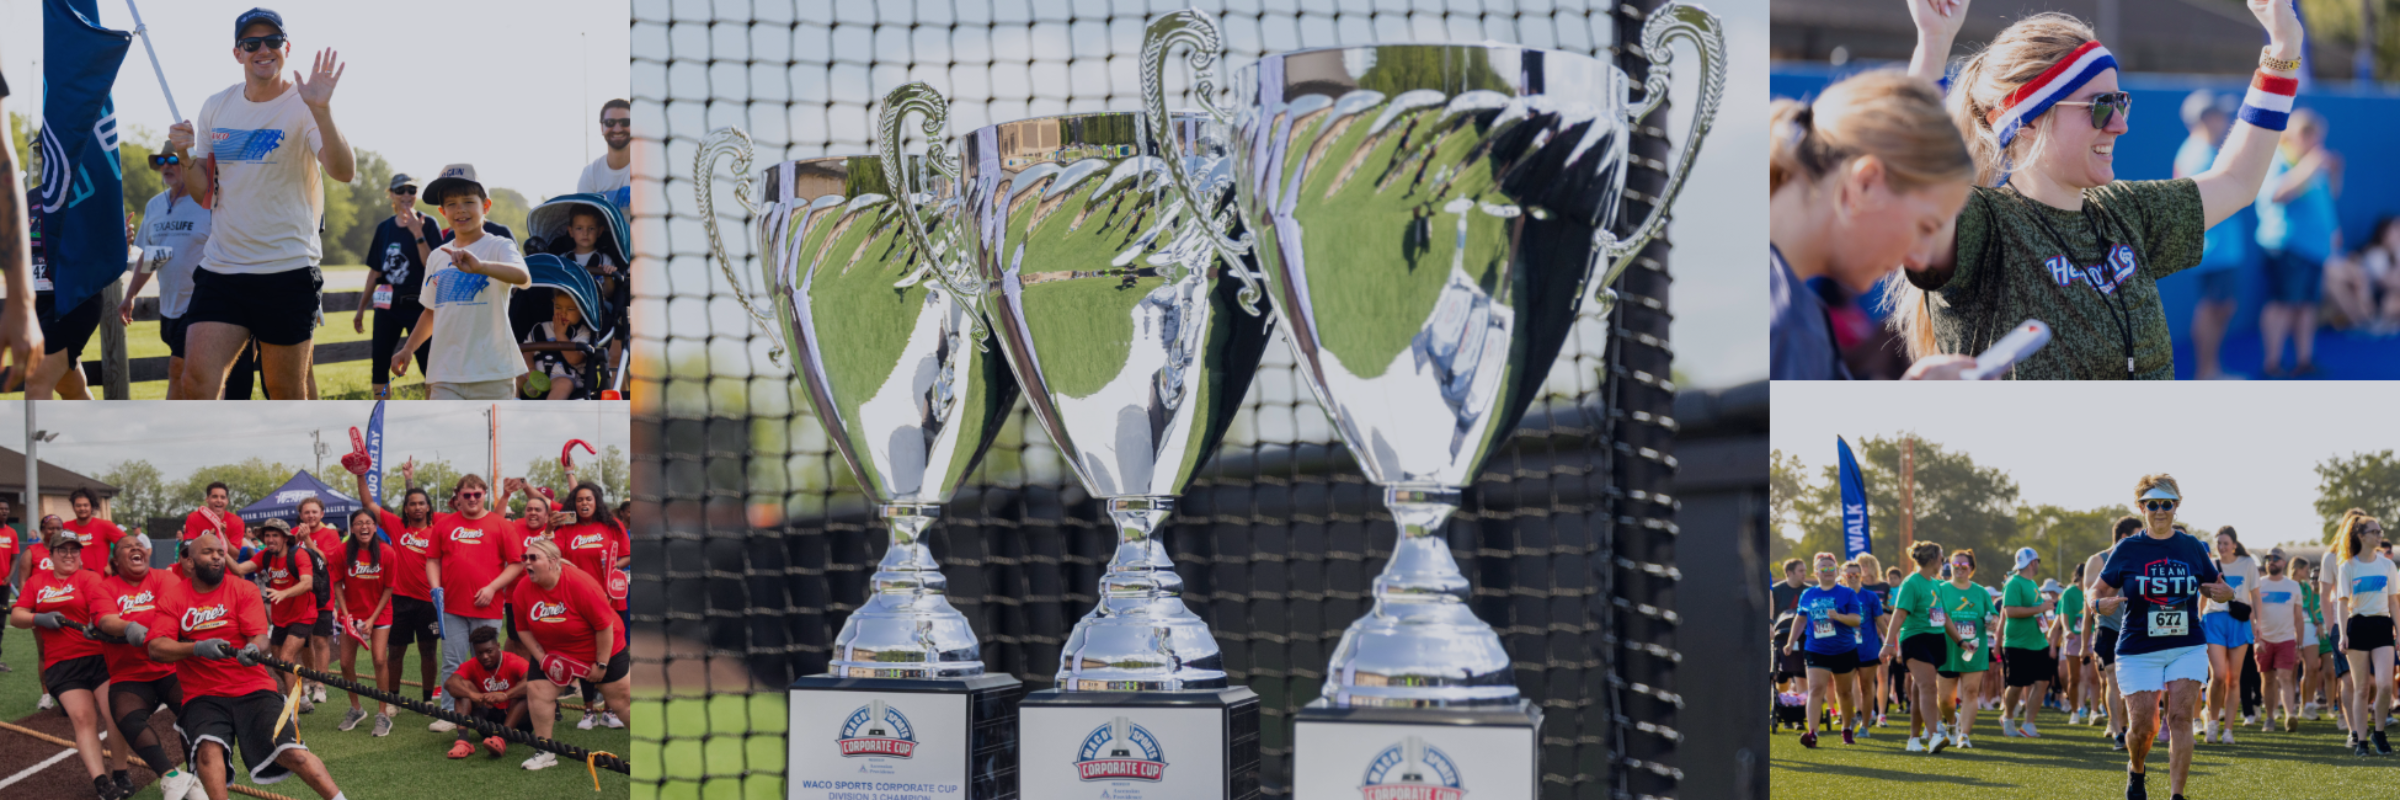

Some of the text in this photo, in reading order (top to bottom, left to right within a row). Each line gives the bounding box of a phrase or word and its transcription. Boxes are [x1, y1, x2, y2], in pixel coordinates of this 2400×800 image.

[369, 430, 381, 472] RELAY
[1846, 503, 1865, 552] WALK
[2150, 567, 2186, 576] TEAM
[2135, 575, 2197, 595] TSTC
[181, 603, 228, 632] Cane's
[530, 601, 567, 621] Cane's
[2156, 612, 2181, 626] 677
[844, 712, 910, 738] WACO SPORTS
[843, 740, 910, 754] CORPORATE CUP
[1082, 730, 1158, 759] WACO SPORTS
[1082, 762, 1160, 777] CORPORATE CUP
[802, 780, 958, 794] WACO SPORTS CORPORATE CUP
[1368, 787, 1458, 800] CORPORATE CUP
[828, 792, 870, 800] DIVISION
